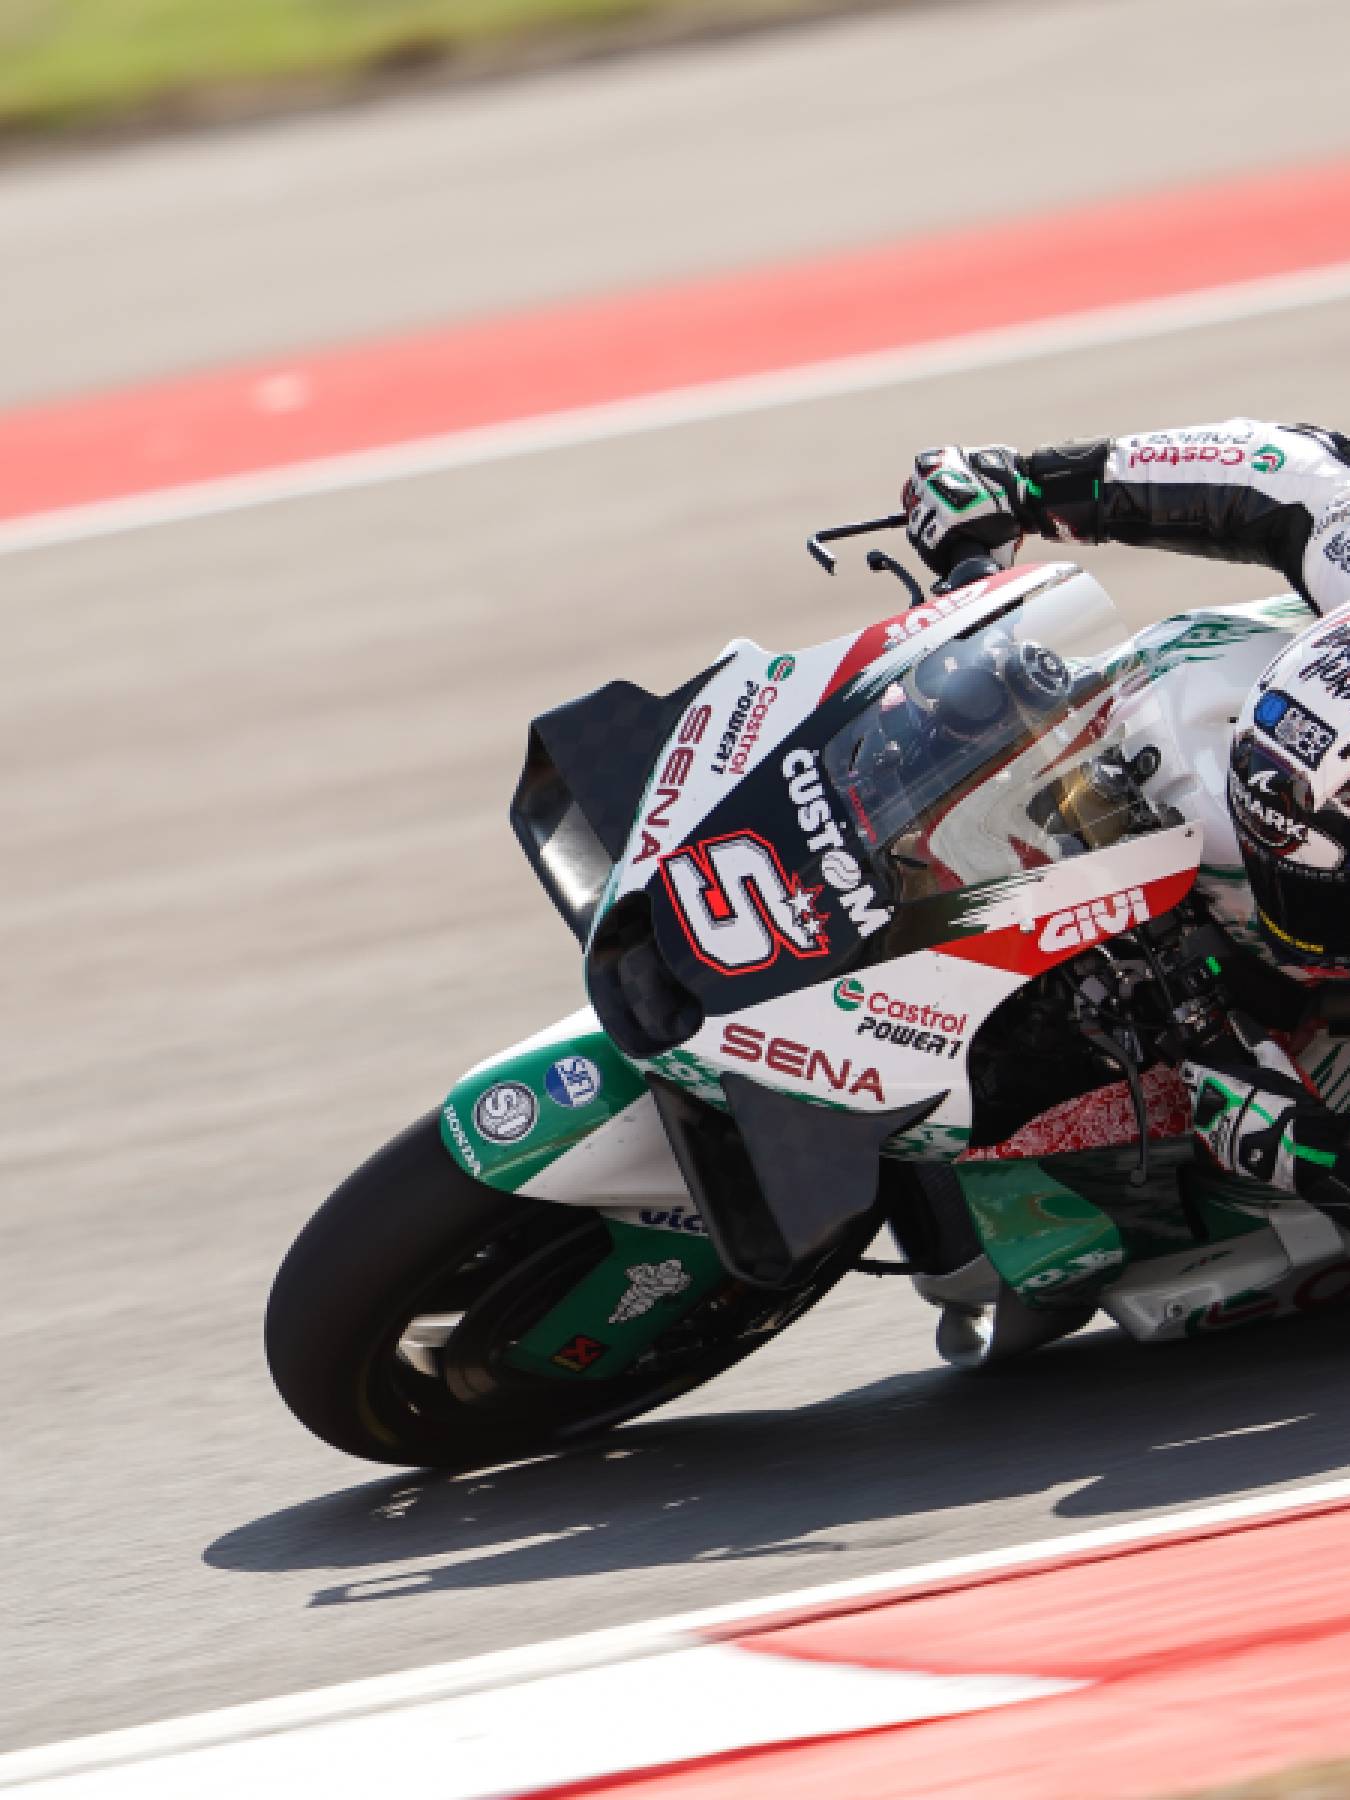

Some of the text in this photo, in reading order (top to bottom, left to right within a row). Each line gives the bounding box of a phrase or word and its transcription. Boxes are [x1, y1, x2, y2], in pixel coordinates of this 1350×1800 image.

[1128, 443, 1245, 470] Castrol
[728, 686, 779, 776] Castrol
[634, 704, 713, 865] SENA
[659, 829, 829, 976] 5
[1037, 887, 1151, 953] GIVI
[857, 1016, 964, 1060] POWER1
[867, 990, 968, 1035] Castrol
[719, 1022, 887, 1104] SENA
[444, 1103, 482, 1177] HONDA
